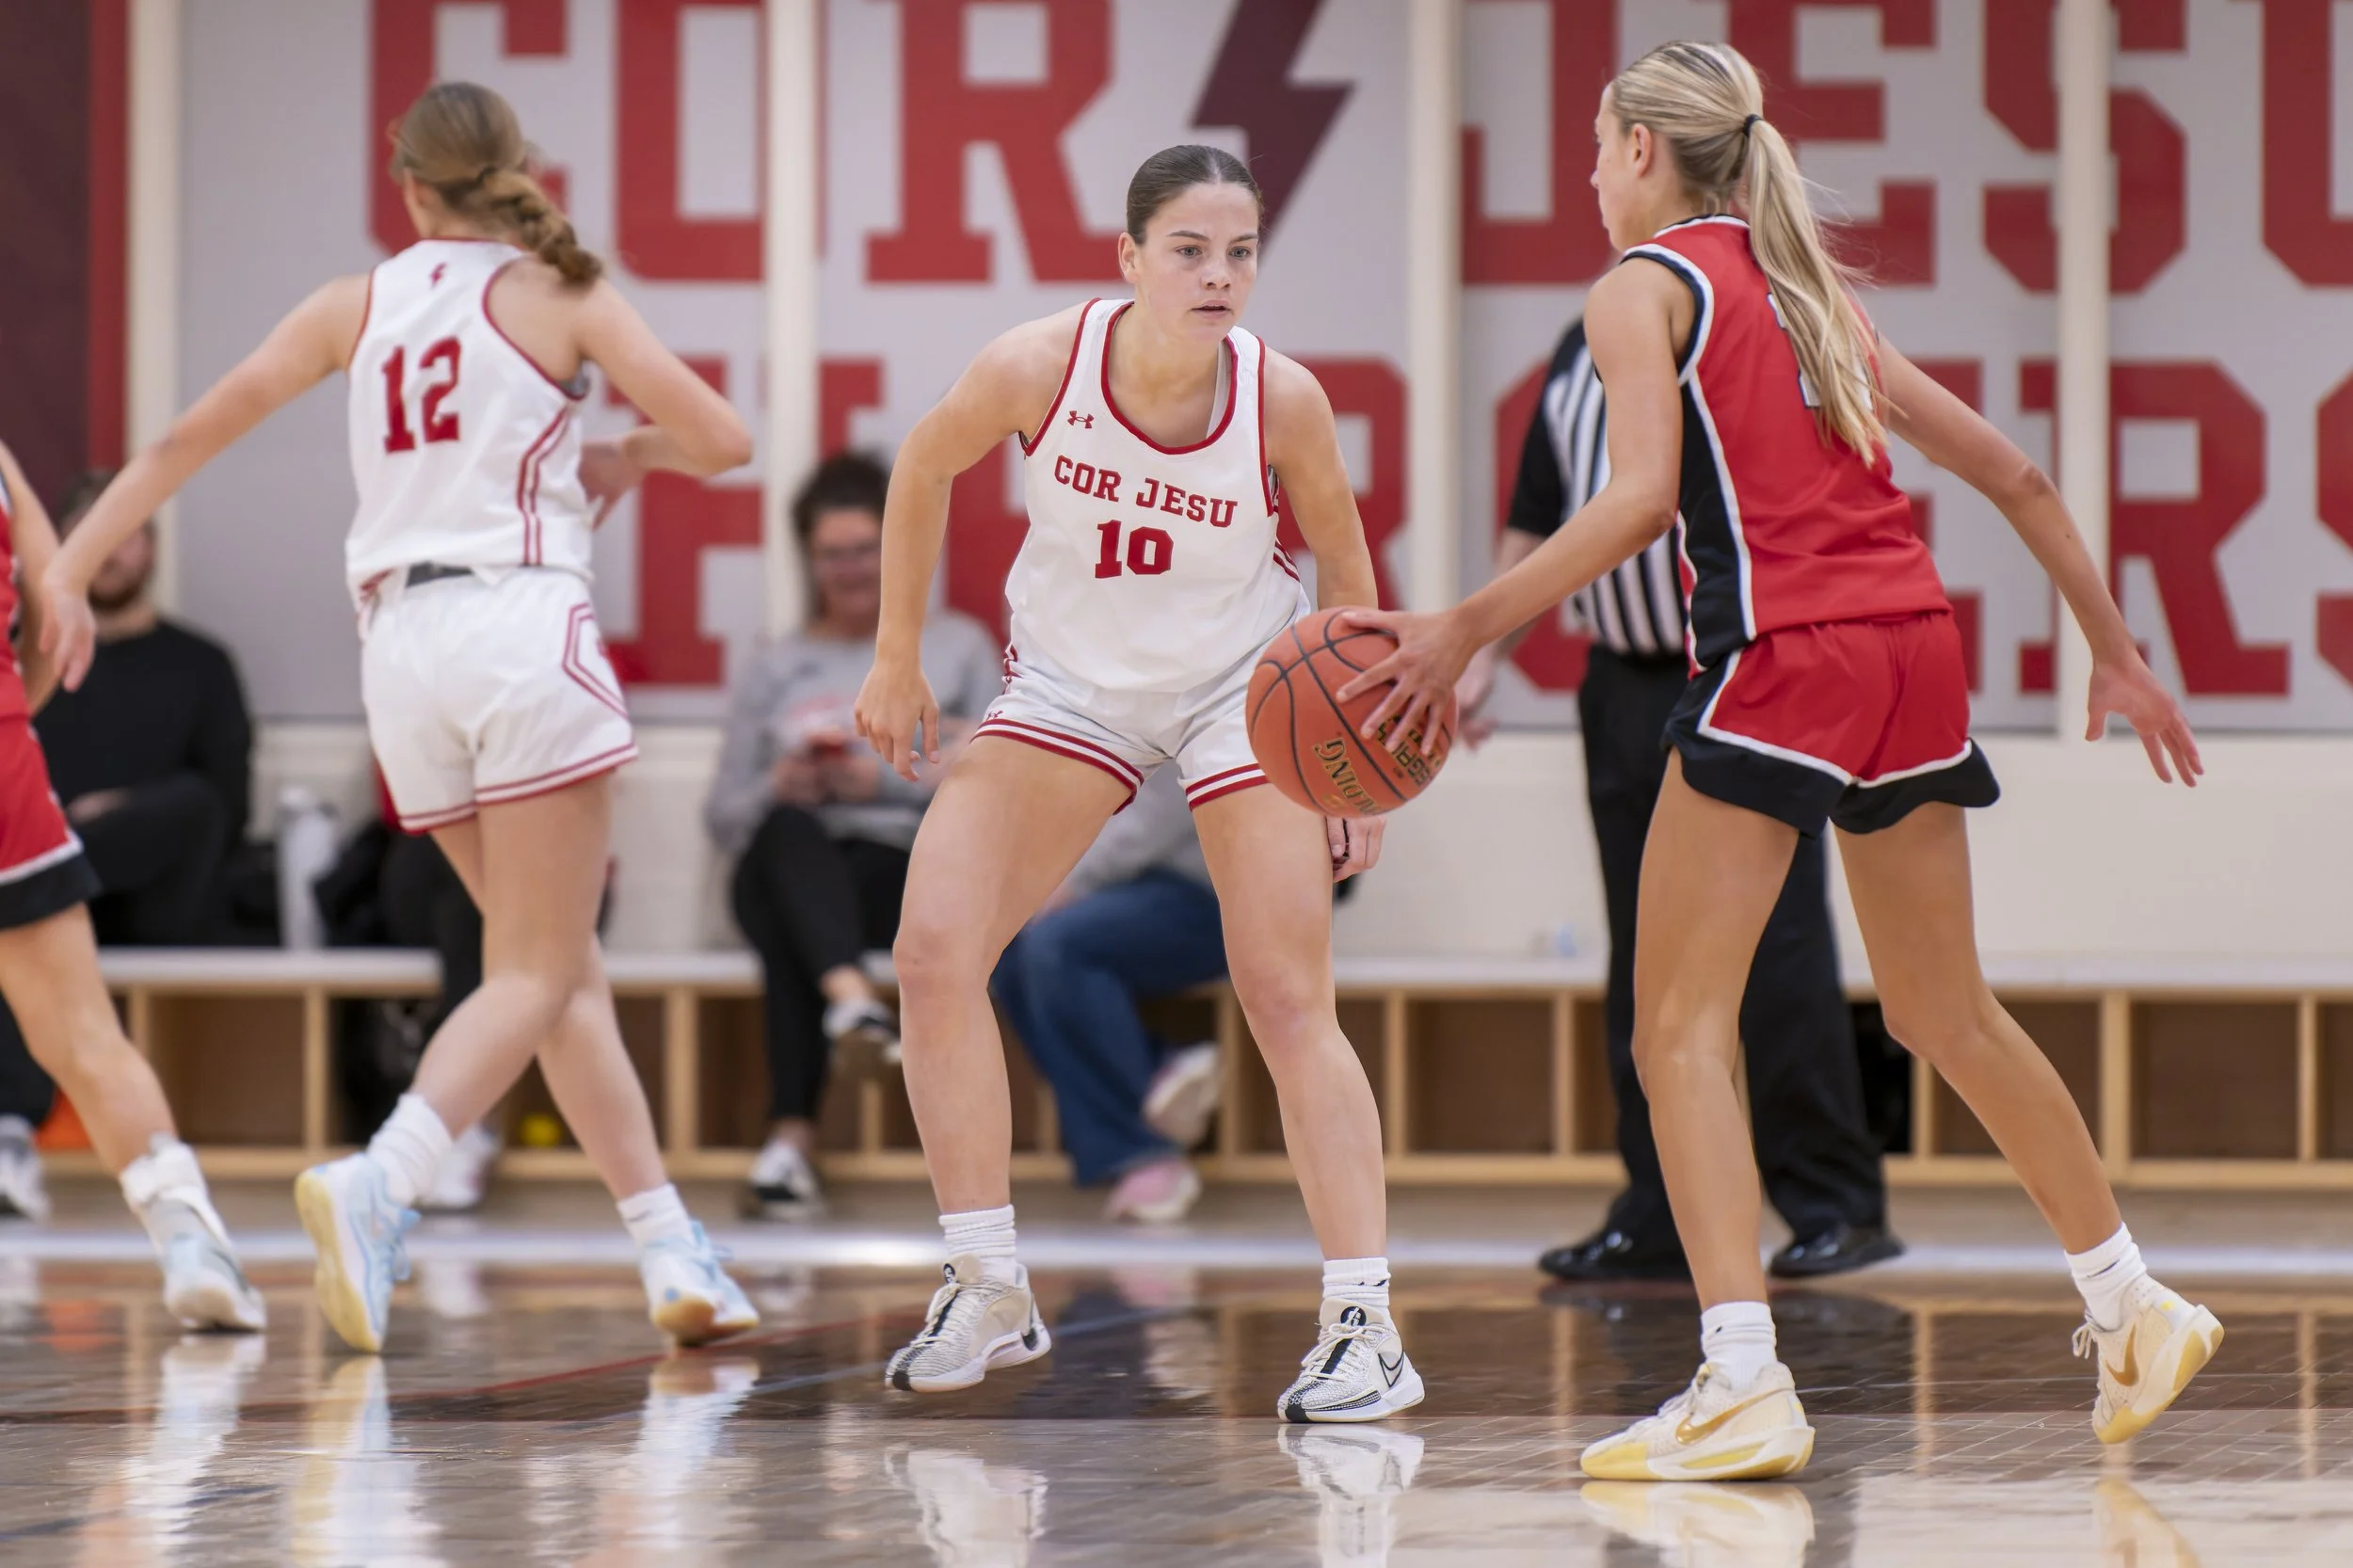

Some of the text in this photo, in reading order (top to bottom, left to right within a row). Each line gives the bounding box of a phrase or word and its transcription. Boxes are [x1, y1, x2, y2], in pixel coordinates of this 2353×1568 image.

[367, 0, 1122, 284] COR
[381, 335, 461, 455] 12
[1053, 454, 1239, 529] COR JESU
[1095, 519, 1175, 579] 10
